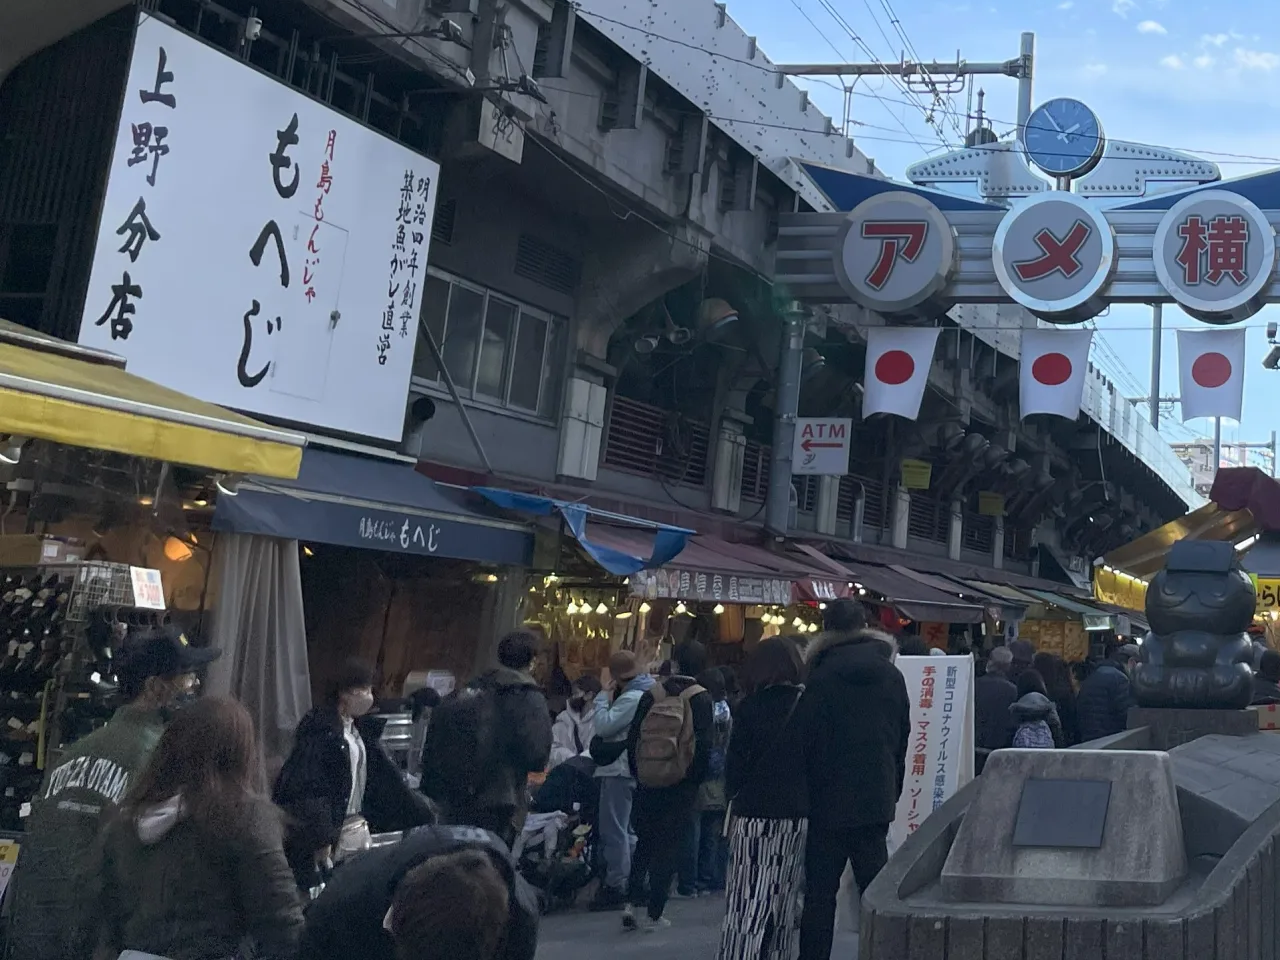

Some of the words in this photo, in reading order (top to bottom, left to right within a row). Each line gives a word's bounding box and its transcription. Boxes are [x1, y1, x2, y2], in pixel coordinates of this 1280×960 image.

[96, 46, 177, 340] 上野分店
[236, 112, 300, 388] もへじ
[302, 129, 337, 305] 月島もんじゃ
[397, 175, 431, 339] 明治四年創業
[860, 214, 1251, 290] アメ横
[801, 423, 845, 438] ATM
[400, 518, 440, 552] もへじ
